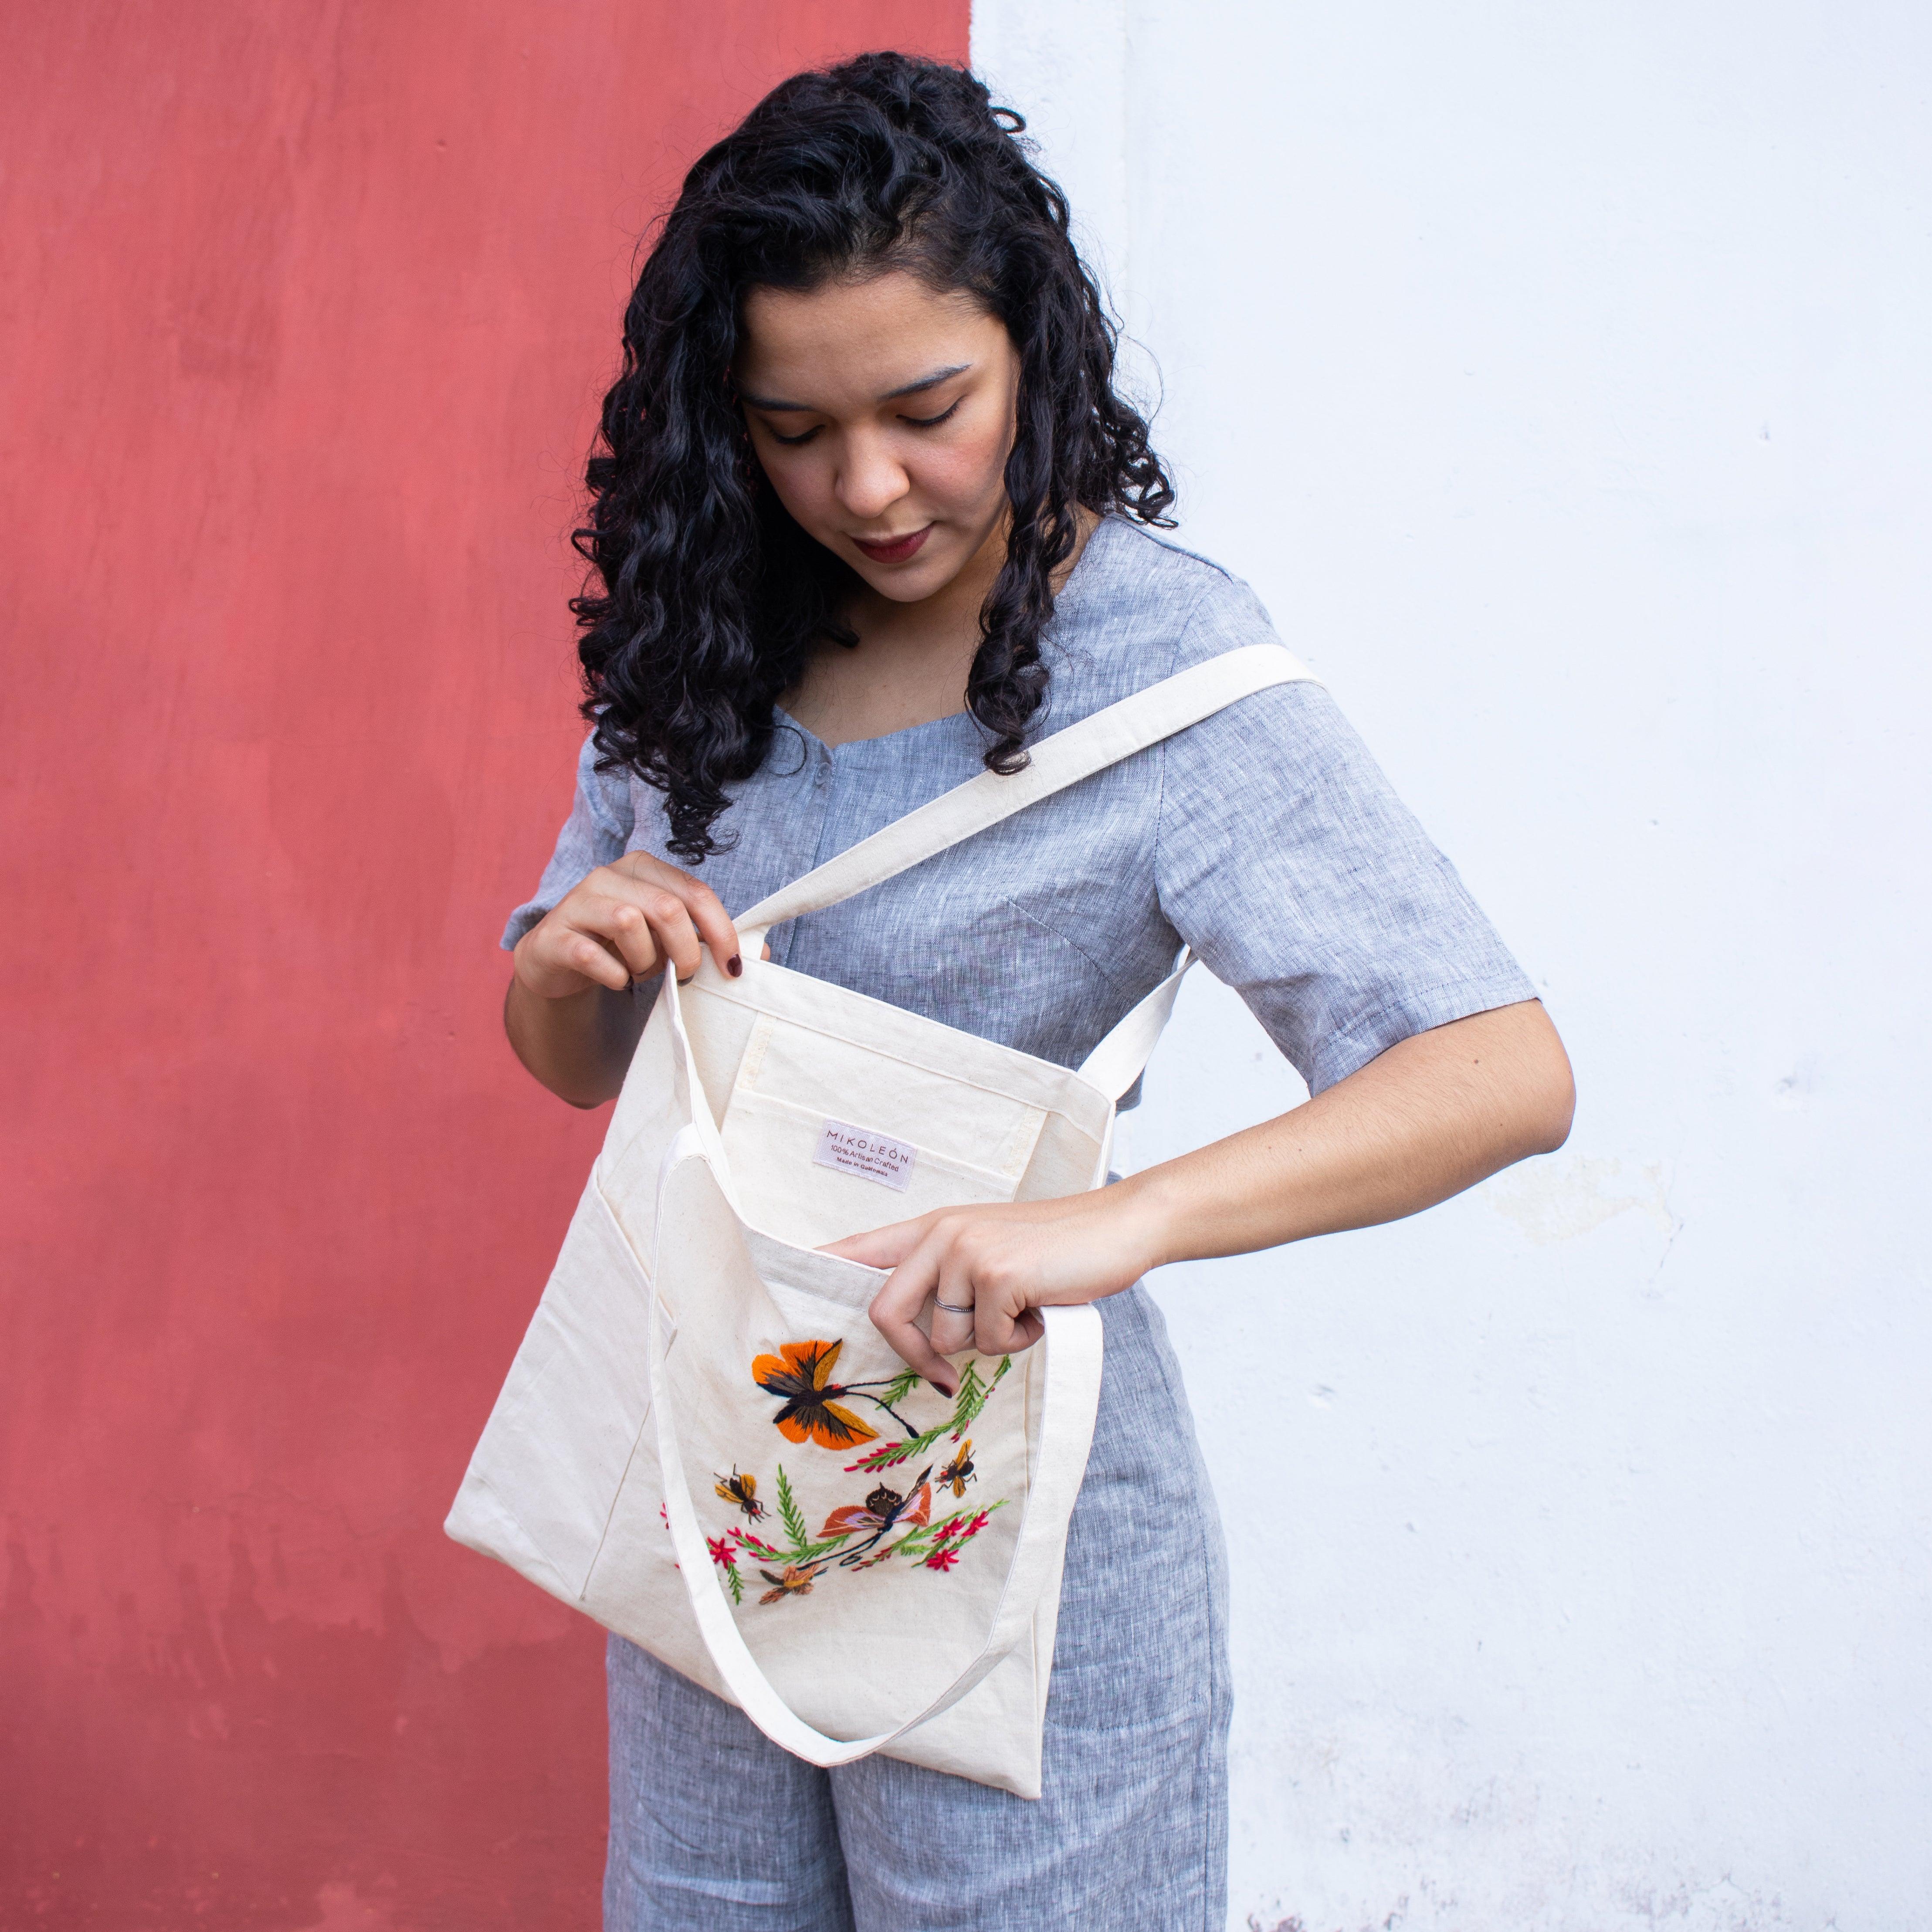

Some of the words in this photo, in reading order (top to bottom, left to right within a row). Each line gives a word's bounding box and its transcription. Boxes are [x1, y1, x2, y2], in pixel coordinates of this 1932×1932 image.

[827, 1130, 908, 1164] MIKOLEÓN
[831, 1145, 848, 1155] 100%
[849, 1150, 873, 1162] Artisan
[874, 1158, 899, 1172] Crafted
[837, 1157, 852, 1165] Made
[861, 1164, 888, 1176] Guatemala
